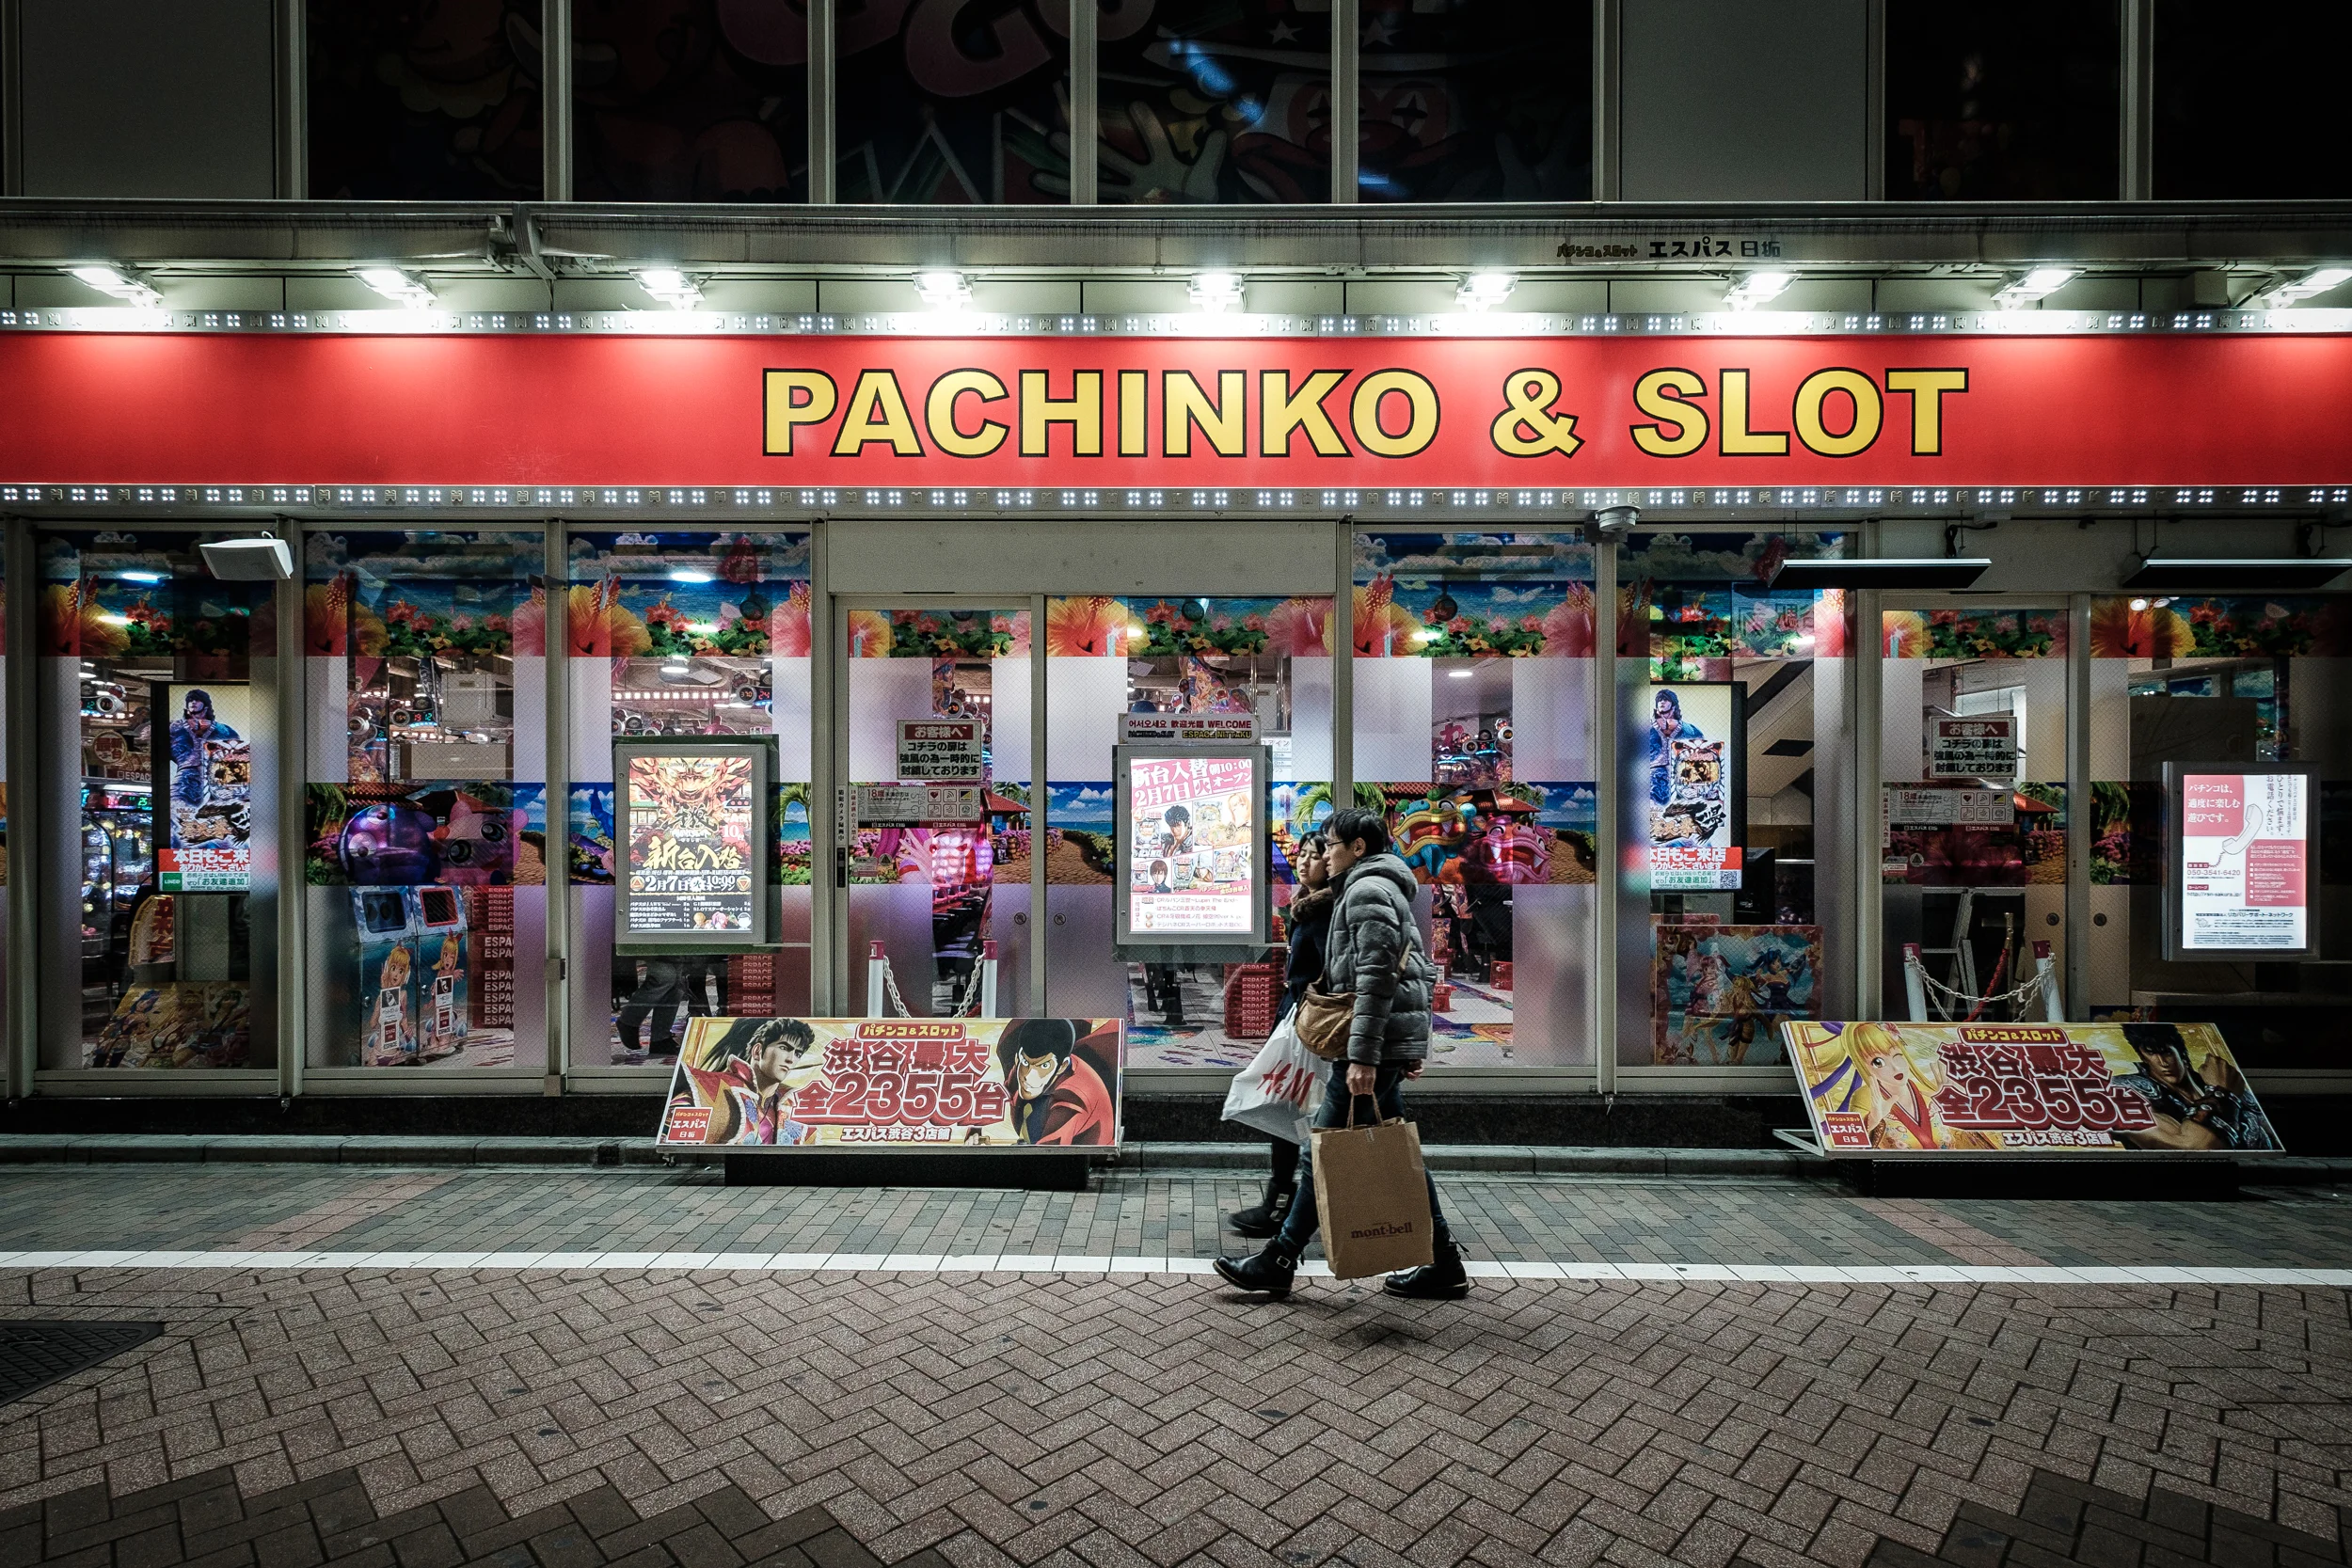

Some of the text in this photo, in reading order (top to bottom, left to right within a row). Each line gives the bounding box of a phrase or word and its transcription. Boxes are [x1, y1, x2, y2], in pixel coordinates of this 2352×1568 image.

[1649, 236, 1732, 258] エスパス
[761, 367, 1969, 459] PACHINKO & SLOT
[1129, 720, 1168, 729] 어서오세요
[1208, 720, 1252, 729] WELCOME
[1948, 722, 1998, 735] お客様へ
[914, 726, 963, 738] お客様へ
[1183, 730, 1216, 739] ESPACE
[1216, 730, 1252, 739] NITTAKU
[1131, 758, 1210, 789] 新台入替
[1212, 771, 1252, 788] オープン
[2188, 784, 2233, 794] パチンコは、
[2187, 798, 2240, 808] 適度に楽しむ
[2187, 813, 2229, 823] 遊びです。
[485, 937, 514, 946] ESPA
[485, 948, 514, 958] ESPA
[485, 971, 514, 980] ESPA
[485, 982, 514, 991] ESPA
[485, 993, 514, 1003] ESPA
[485, 1005, 514, 1014] ESPA
[485, 1015, 514, 1025] ESPA
[863, 1023, 960, 1037] パチンコ&スロット
[1966, 1028, 2062, 1041] パチンコ&スロット
[822, 1039, 990, 1075] 渋谷最大
[1940, 1043, 2113, 1079] 渋谷最大
[1256, 1060, 1316, 1107] H&M
[793, 1072, 1009, 1120] 全2355台
[1932, 1077, 2153, 1125] 全2355台
[672, 1117, 707, 1129] エスパス
[1830, 1122, 1865, 1133] エスパス
[841, 1126, 951, 1141] エスパス渋谷3店舗
[2003, 1131, 2113, 1146] エスパス渋谷3店舗
